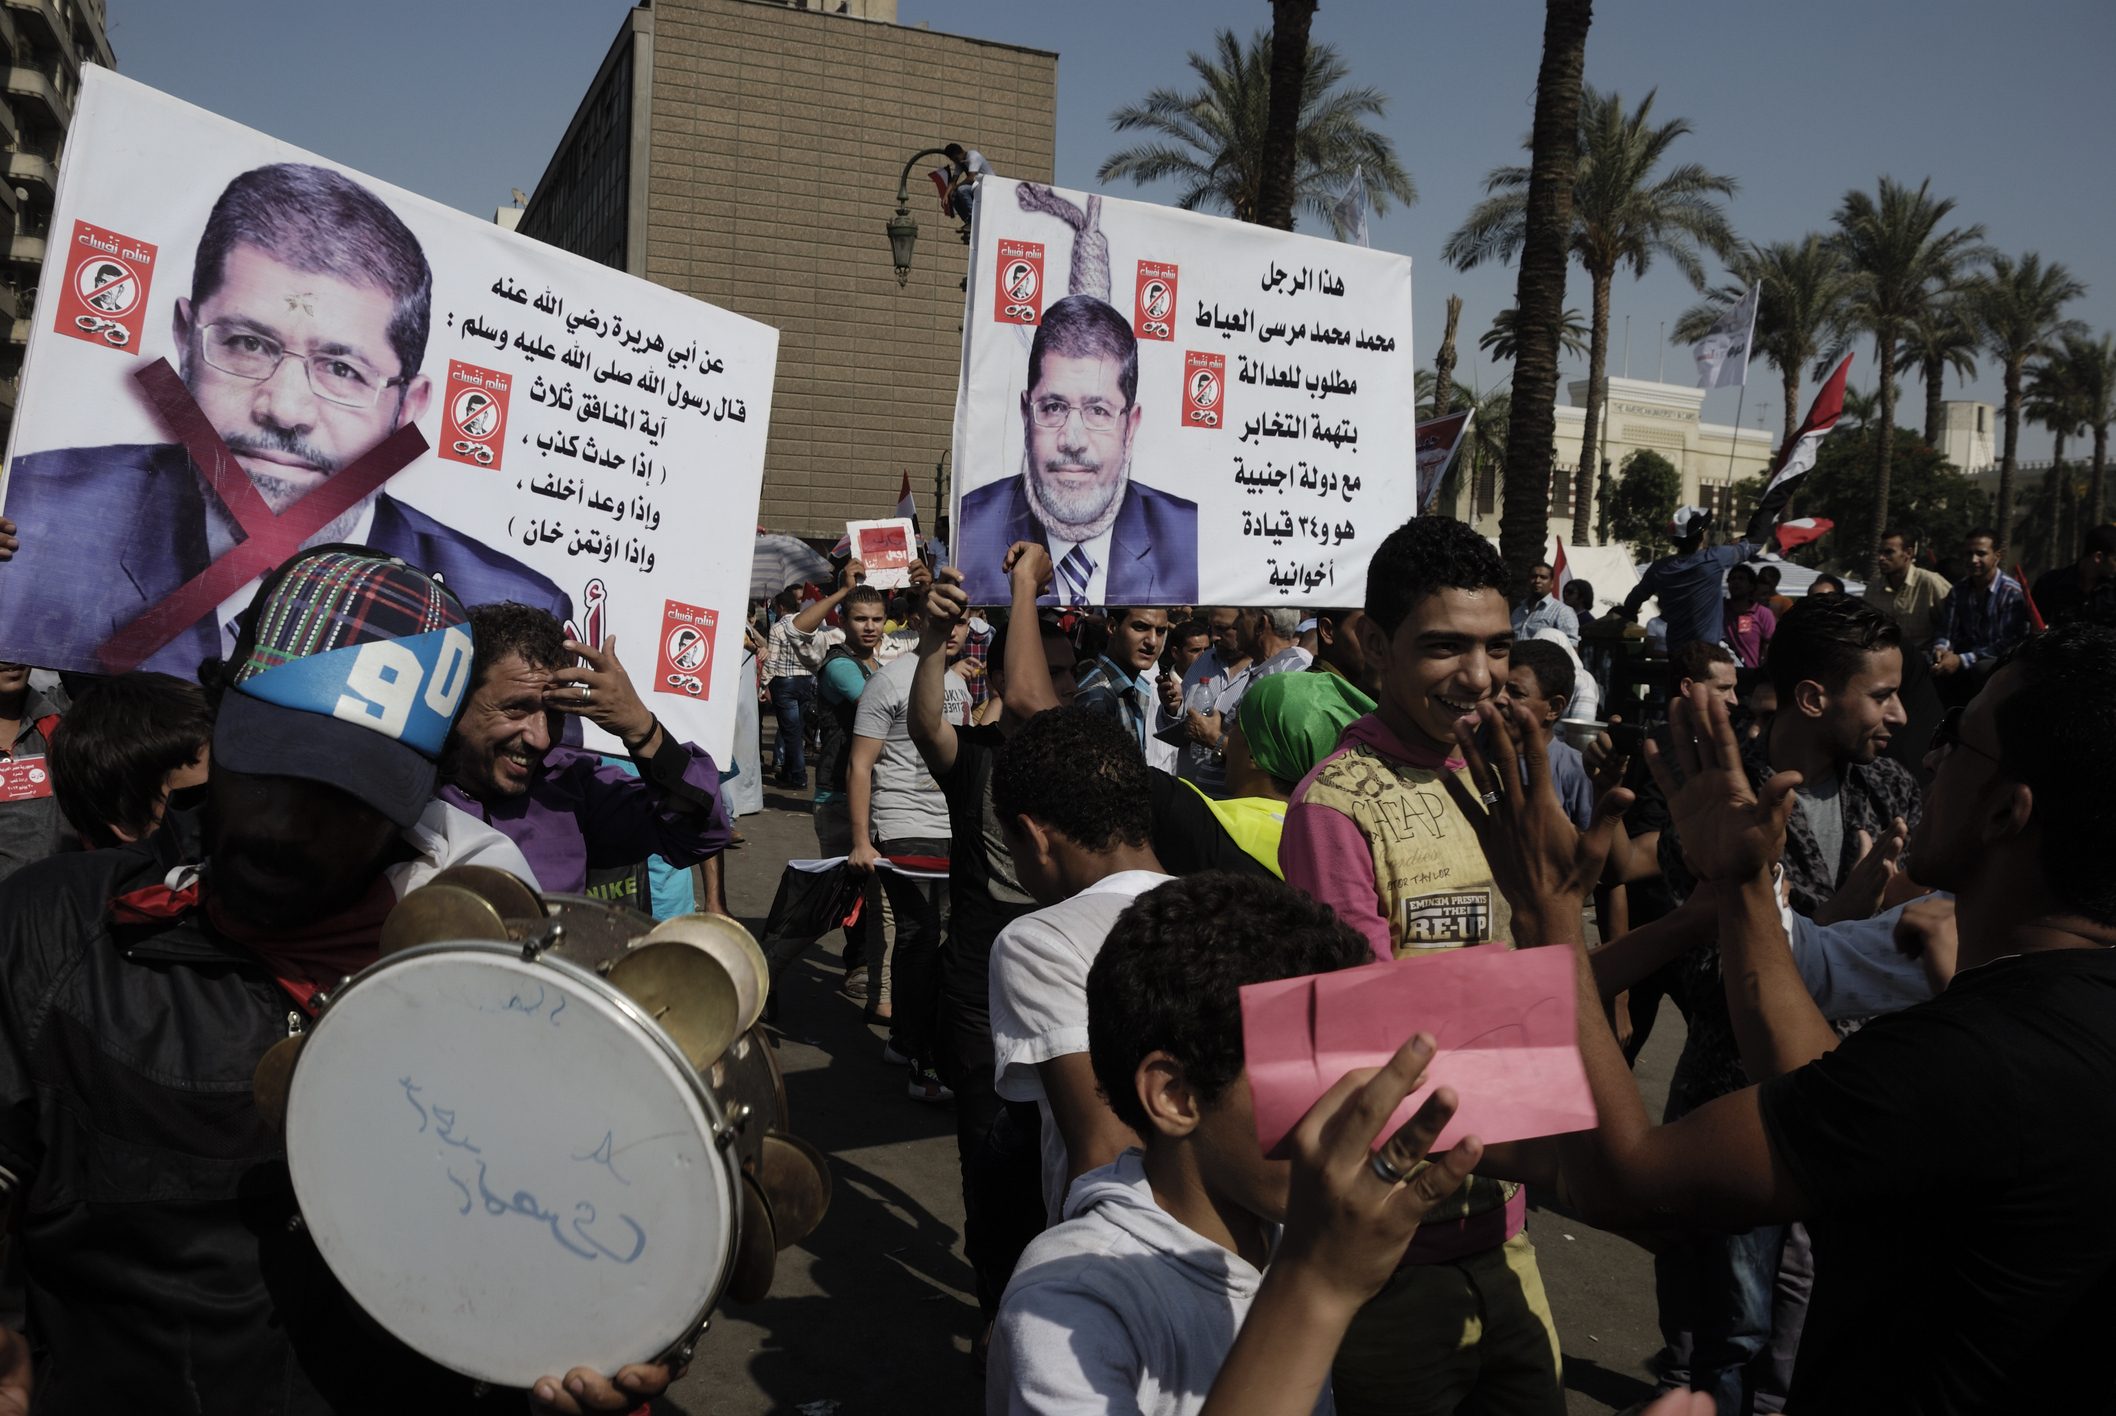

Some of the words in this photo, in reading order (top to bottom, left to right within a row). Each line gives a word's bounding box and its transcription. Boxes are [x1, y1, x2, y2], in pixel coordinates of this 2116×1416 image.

[491, 276, 528, 305] عنه
[1261, 260, 1313, 296] الرجل
[1319, 268, 1345, 297] هذا
[533, 286, 563, 317] الله
[461, 315, 508, 351] وسلم
[565, 309, 608, 338] رضي
[612, 316, 665, 354] هريرة
[1195, 300, 1254, 339] العياط
[1259, 322, 1306, 346] مرسى
[1310, 321, 1351, 345] محمد
[513, 331, 556, 362] عليه
[561, 340, 591, 371] الله
[667, 339, 697, 369] أبي
[1355, 328, 1395, 352] محمد
[594, 360, 633, 385] صلى
[699, 350, 725, 374] عن
[1238, 354, 1301, 389] للعدالة
[530, 376, 573, 411] ثلاث
[637, 364, 666, 396] الله
[1305, 368, 1357, 399] مطلوب
[576, 392, 635, 430] المنافق
[667, 382, 711, 416] رسول
[713, 396, 747, 423] قال
[639, 408, 668, 446] آية
[1238, 411, 1307, 446] التخابر
[1310, 413, 1358, 454] بتهمة
[582, 437, 626, 469] حدث
[632, 452, 653, 486] إذا
[1233, 456, 1294, 495] اجنبية
[1298, 461, 1338, 497] دولة
[1341, 473, 1361, 503] مع
[587, 490, 625, 521] وعد
[631, 495, 660, 531] وإذا
[523, 519, 564, 546] خان
[1242, 510, 1294, 546] قيادة
[1332, 519, 1355, 546] هو
[567, 529, 619, 563] اؤتمن
[625, 537, 656, 573] وإذا
[1266, 558, 1335, 595] أخوانية
[586, 876, 638, 900] NIKE
[1411, 868, 1450, 884] TAYLOR
[1443, 906, 1466, 915] THE
[1451, 895, 1487, 905] PRESENTS
[1407, 916, 1487, 940] RE-UP
